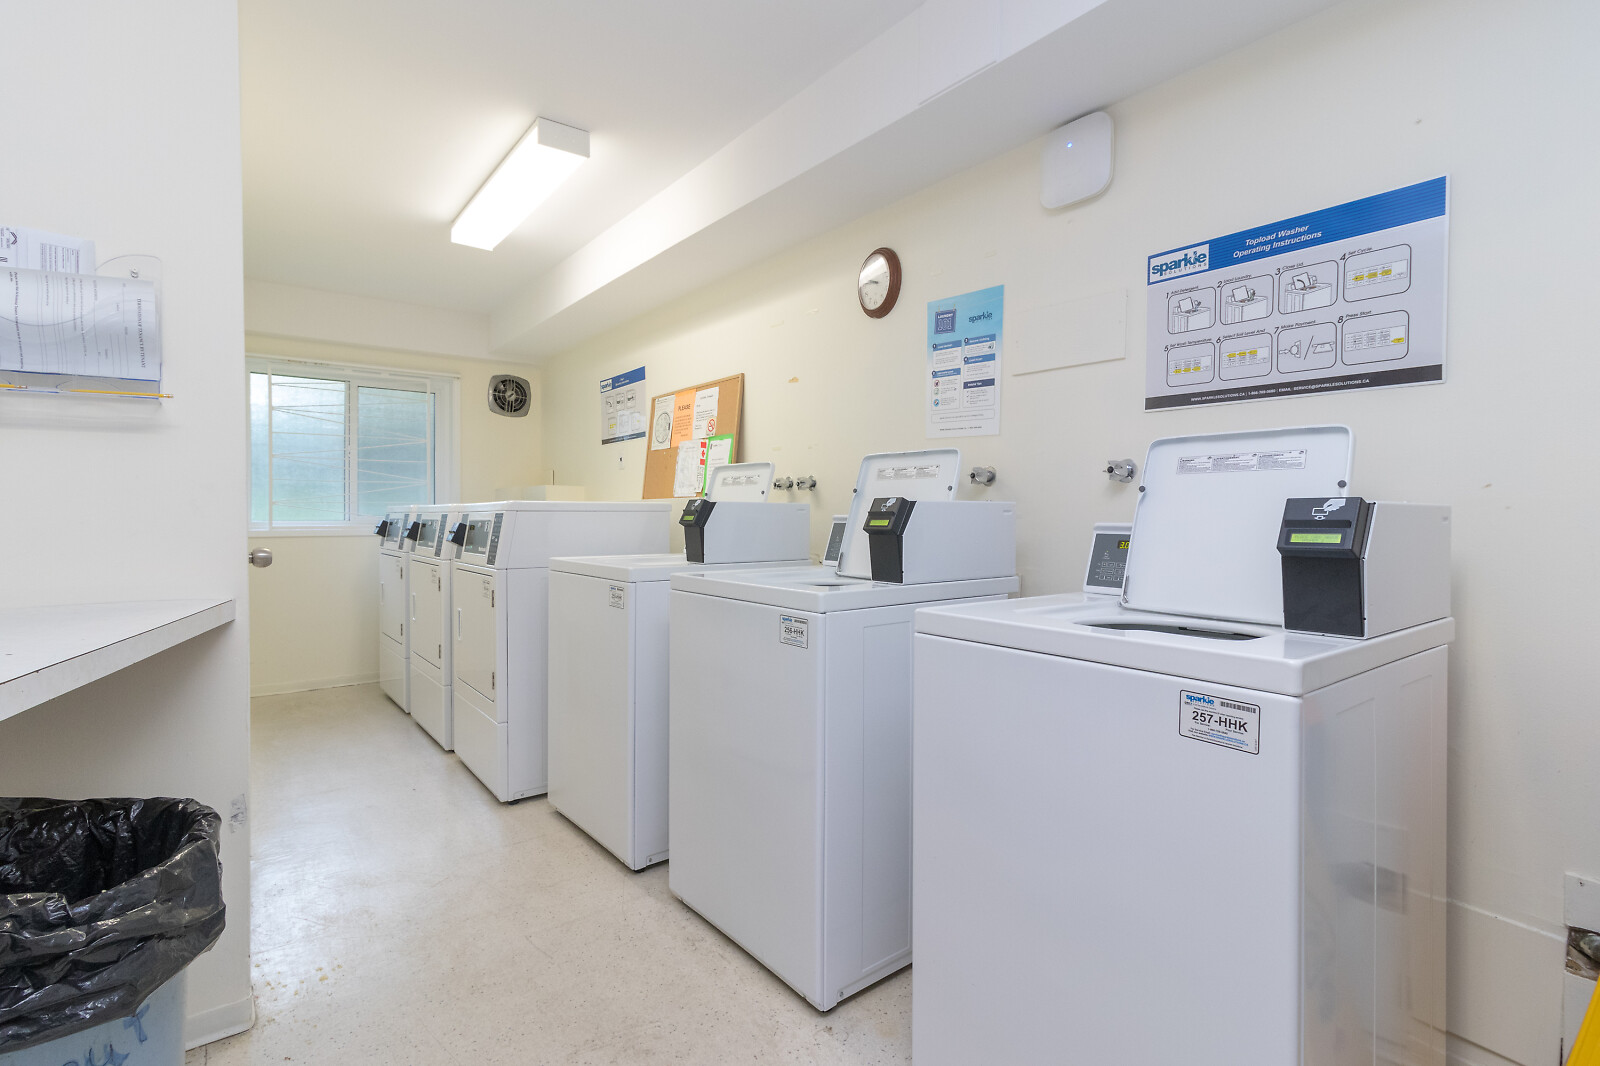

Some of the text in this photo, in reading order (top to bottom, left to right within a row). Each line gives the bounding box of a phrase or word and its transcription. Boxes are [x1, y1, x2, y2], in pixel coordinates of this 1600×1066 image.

[1233, 231, 1322, 258] Operating Instructions
[1245, 225, 1309, 247] Topload Washer
[1275, 268, 1280, 276] 3
[1338, 316, 1344, 324] 8
[1192, 710, 1248, 732] 257-HHK
